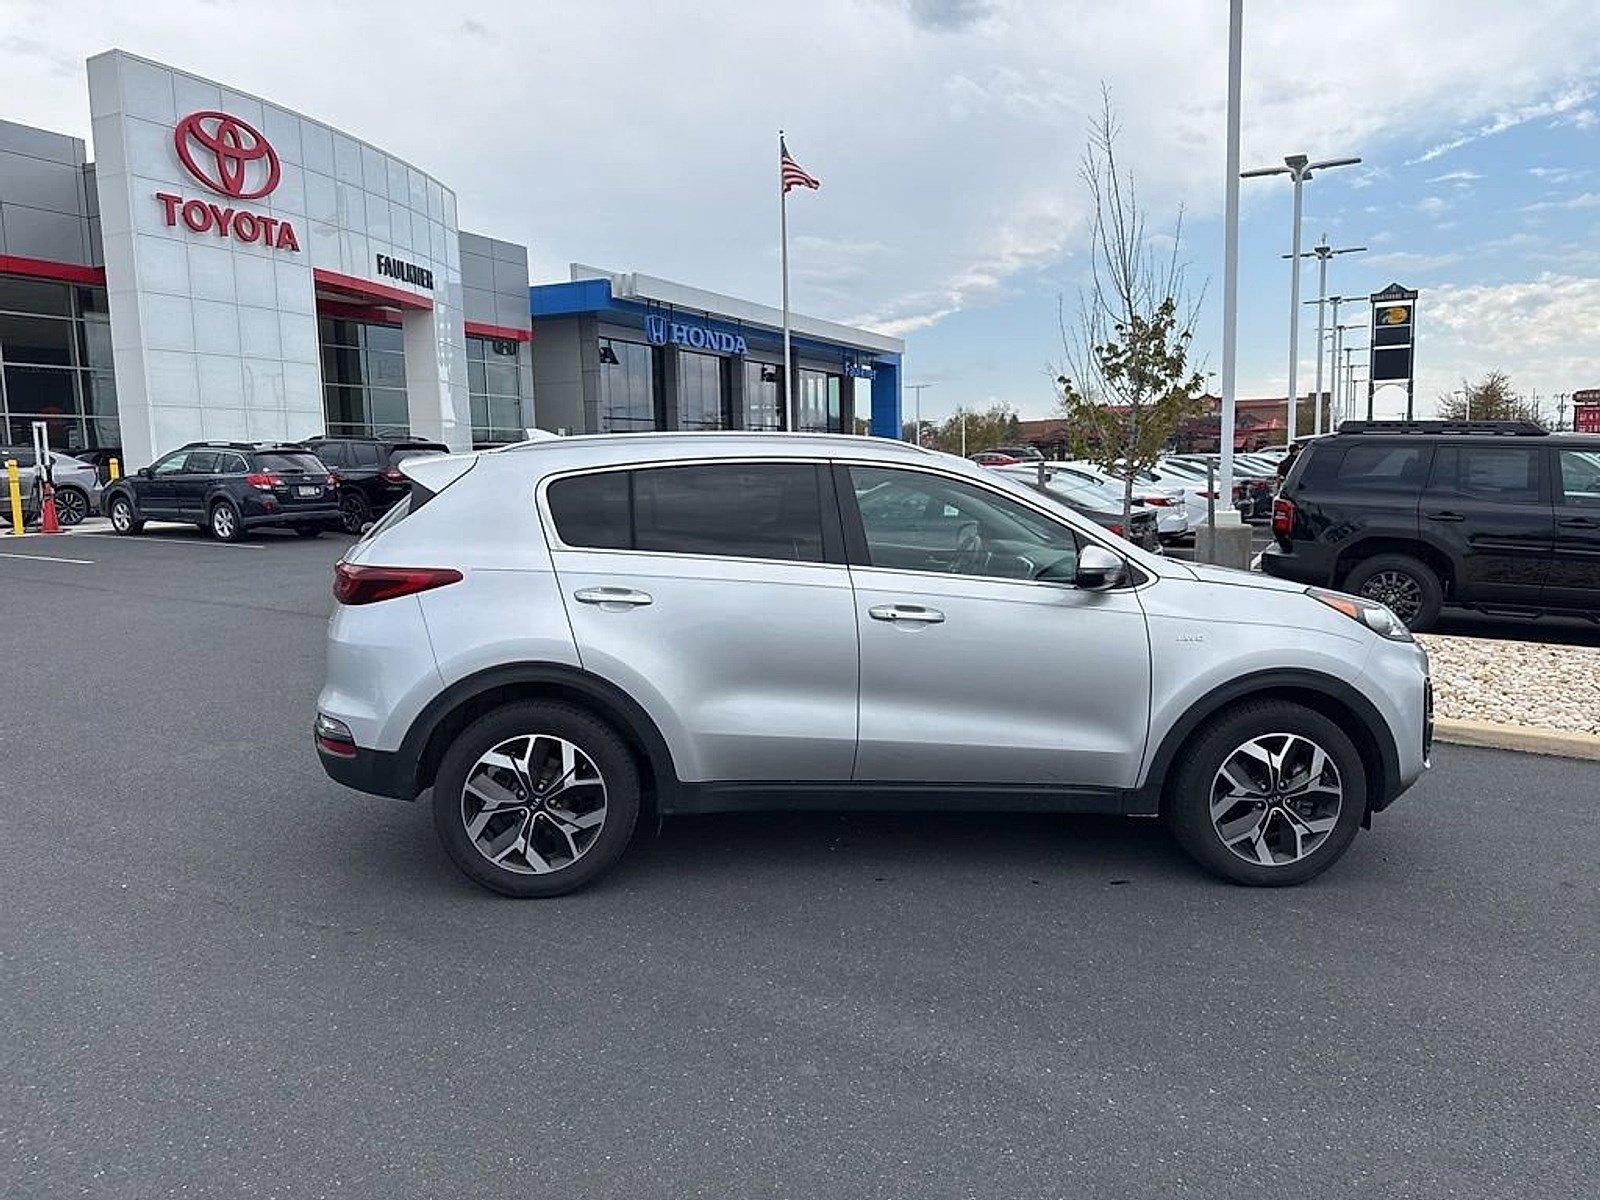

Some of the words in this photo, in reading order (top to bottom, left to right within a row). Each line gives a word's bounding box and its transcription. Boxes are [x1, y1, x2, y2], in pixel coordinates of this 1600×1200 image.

[157, 192, 300, 252] TOYOTA
[377, 253, 434, 290] FAULKNER
[670, 323, 748, 354] HONDA
